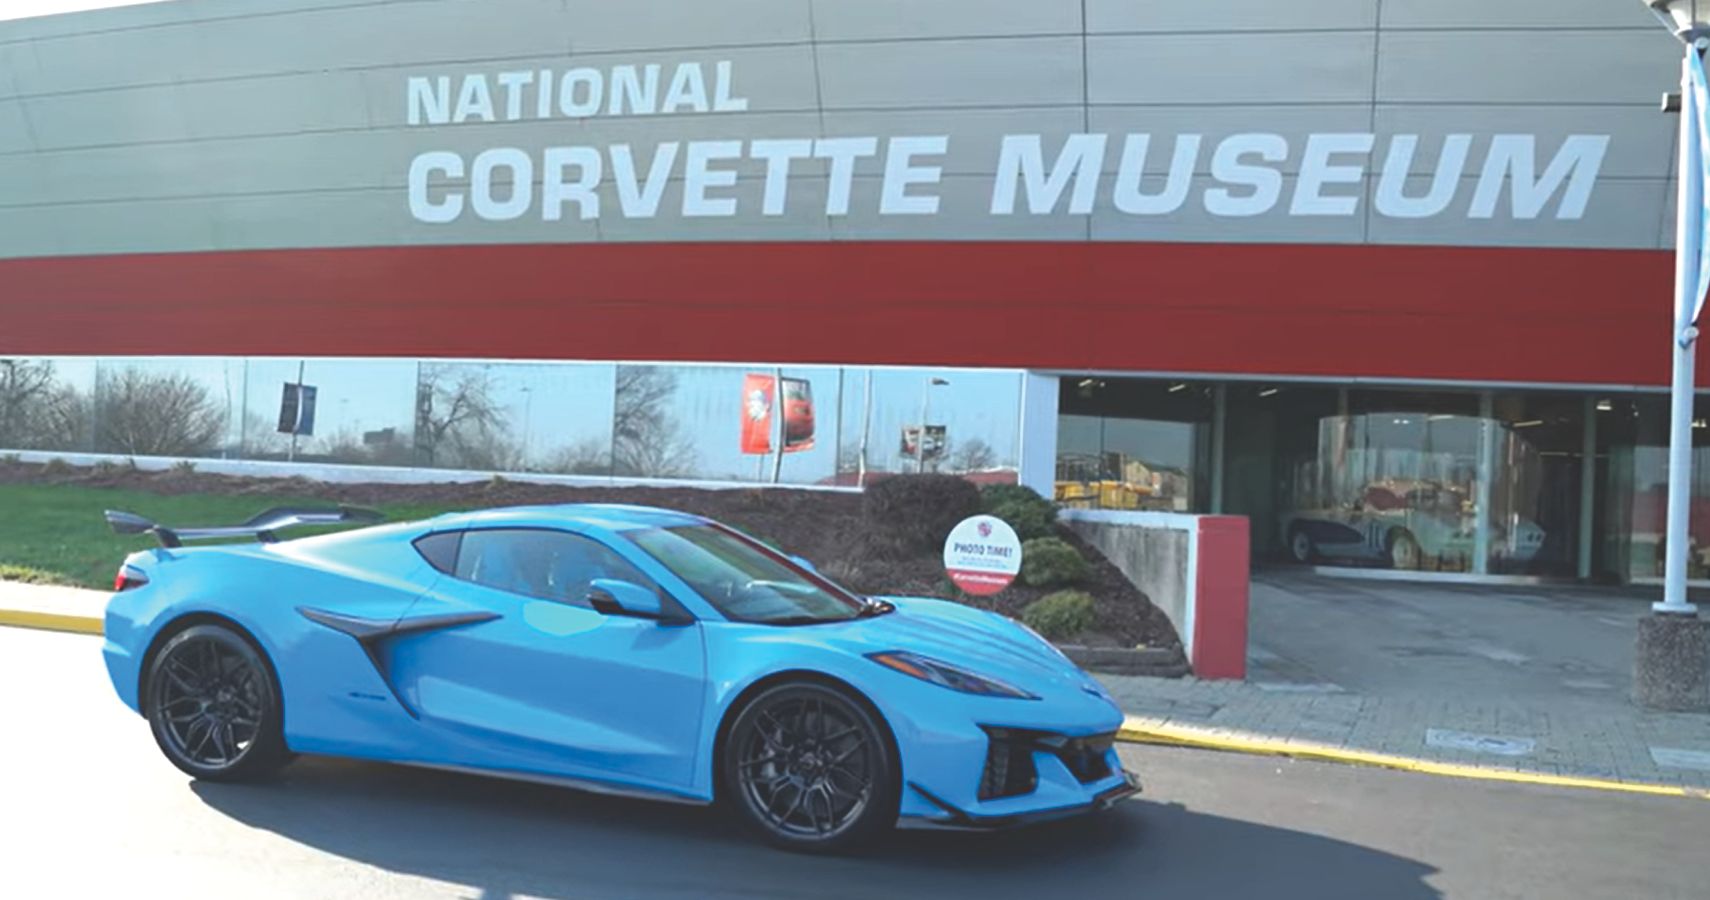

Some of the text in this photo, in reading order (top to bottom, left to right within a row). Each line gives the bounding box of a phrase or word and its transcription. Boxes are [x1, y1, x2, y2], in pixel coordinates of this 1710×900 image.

[407, 60, 748, 125] NATIONAL
[407, 133, 1611, 223] CORVETTE MUSEUM
[954, 542, 1013, 558] PHOTO TIME!
